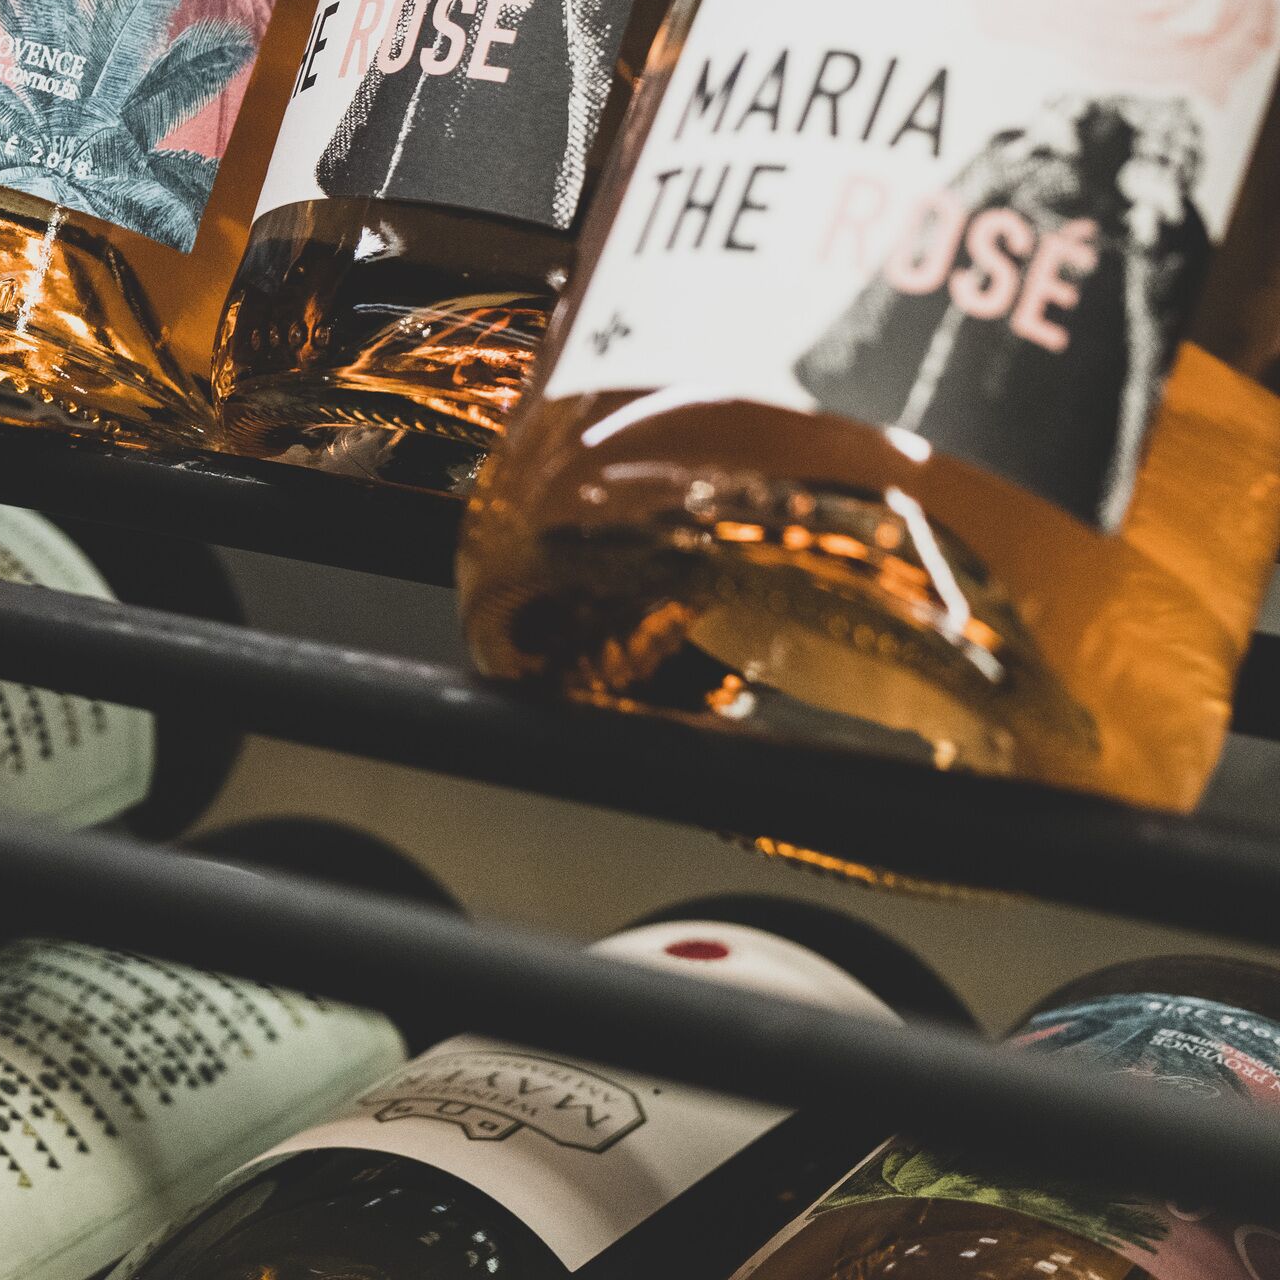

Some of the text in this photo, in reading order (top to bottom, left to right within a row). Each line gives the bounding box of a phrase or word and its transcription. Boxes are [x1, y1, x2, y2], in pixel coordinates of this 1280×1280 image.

[671, 48, 953, 159] MARIA
[28, 145, 93, 179] 2018
[634, 162, 1102, 355] THE ROSÉ
